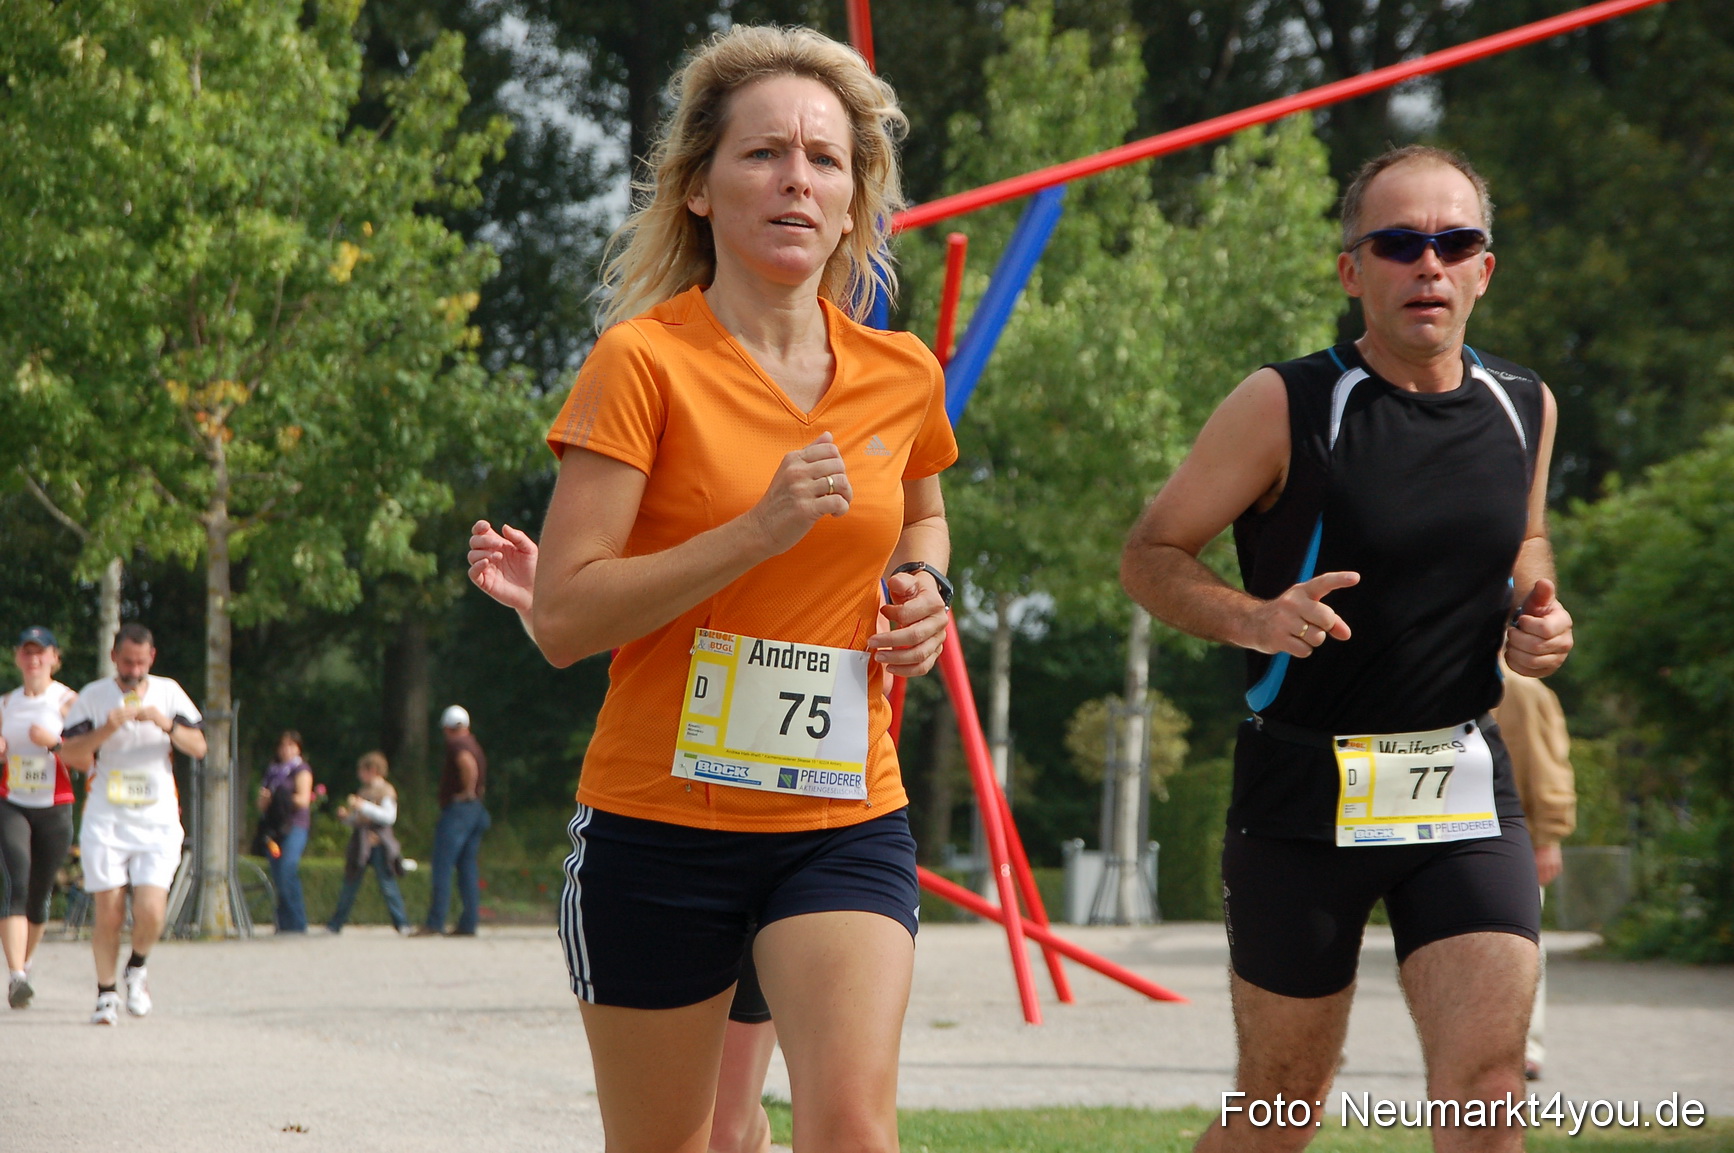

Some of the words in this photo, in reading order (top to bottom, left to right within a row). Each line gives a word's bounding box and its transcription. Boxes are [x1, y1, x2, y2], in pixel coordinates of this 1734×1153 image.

[747, 639, 830, 673] Andrea
[694, 675, 709, 699] D
[779, 691, 832, 740] 75
[695, 759, 750, 778] BOCK
[800, 769, 862, 788] PFLEIDERER
[1348, 768, 1357, 786] D
[1409, 765, 1455, 800] 77
[1435, 820, 1495, 833] PFLEIDERER
